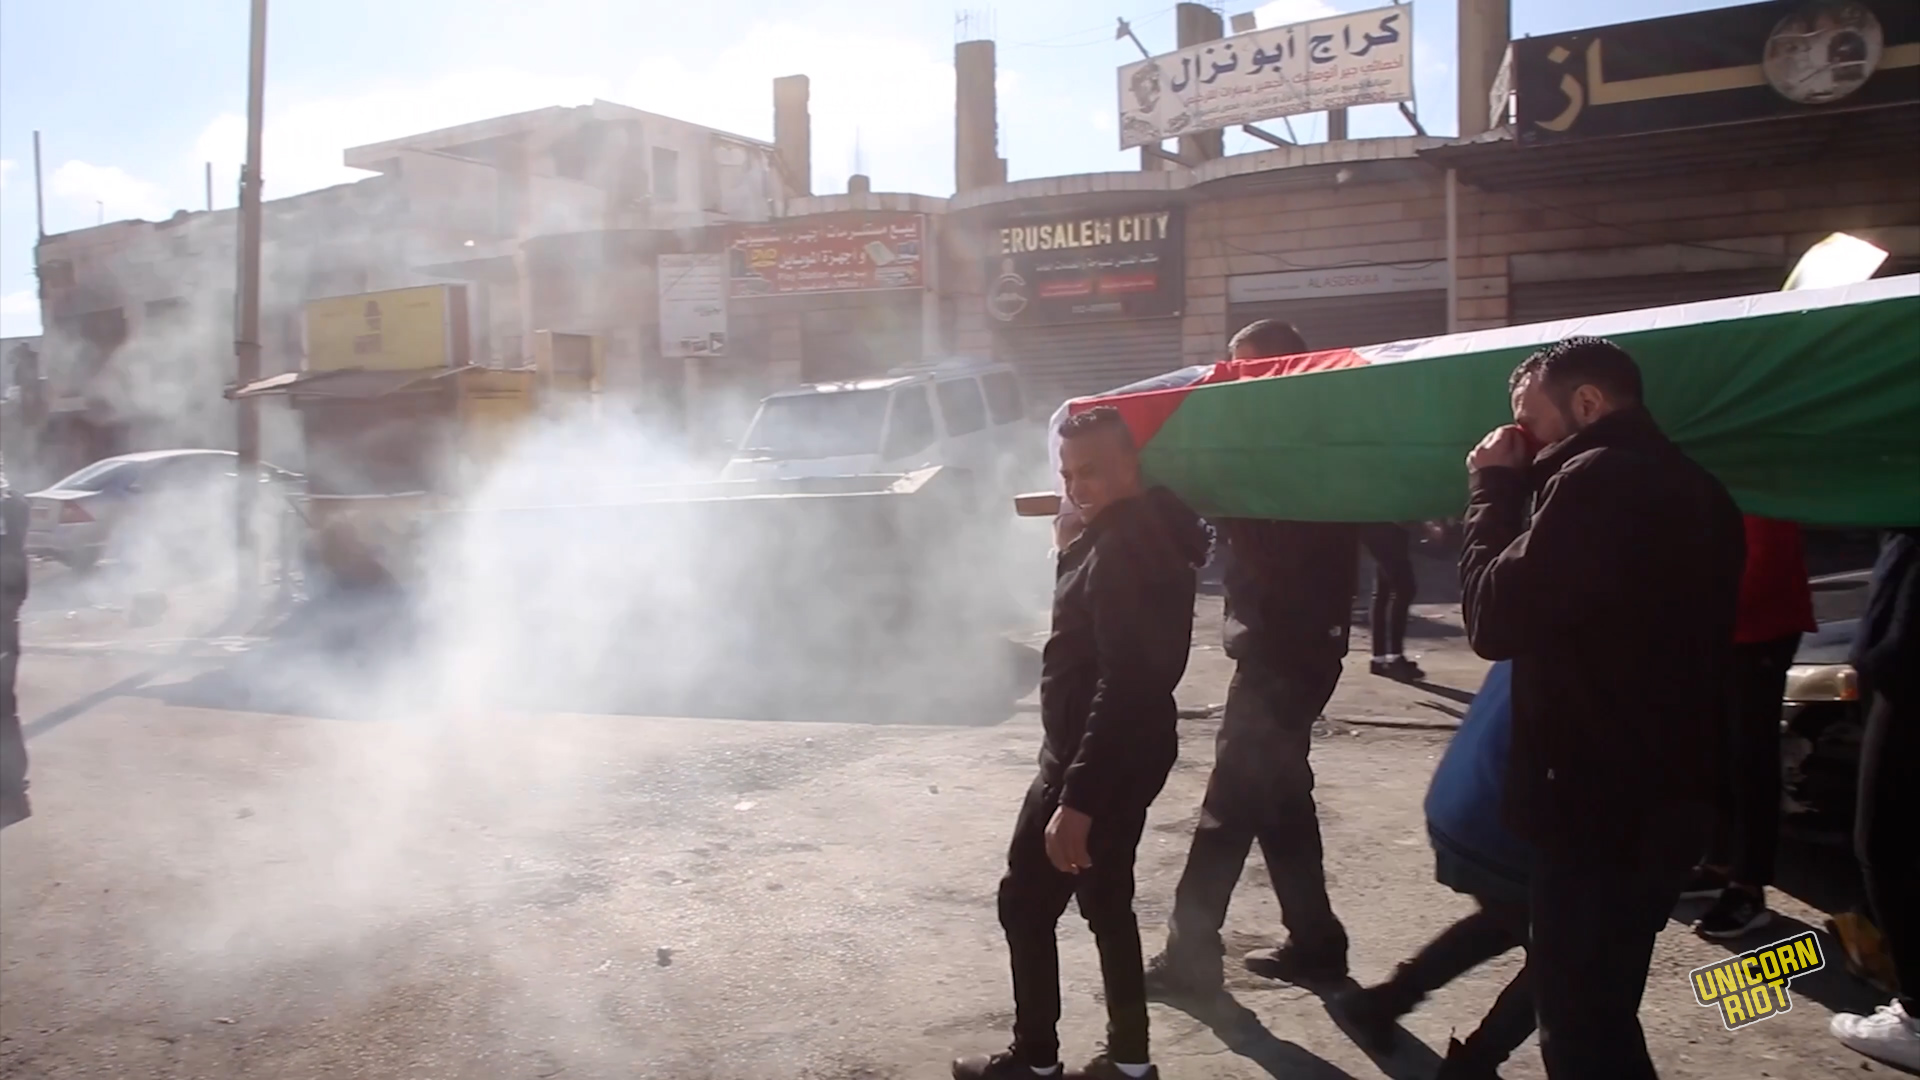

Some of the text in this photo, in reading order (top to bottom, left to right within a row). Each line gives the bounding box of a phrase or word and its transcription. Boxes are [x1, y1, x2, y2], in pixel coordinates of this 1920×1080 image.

[1170, 14, 1400, 93] كراج أبو نزال
[1118, 211, 1170, 243] CITY
